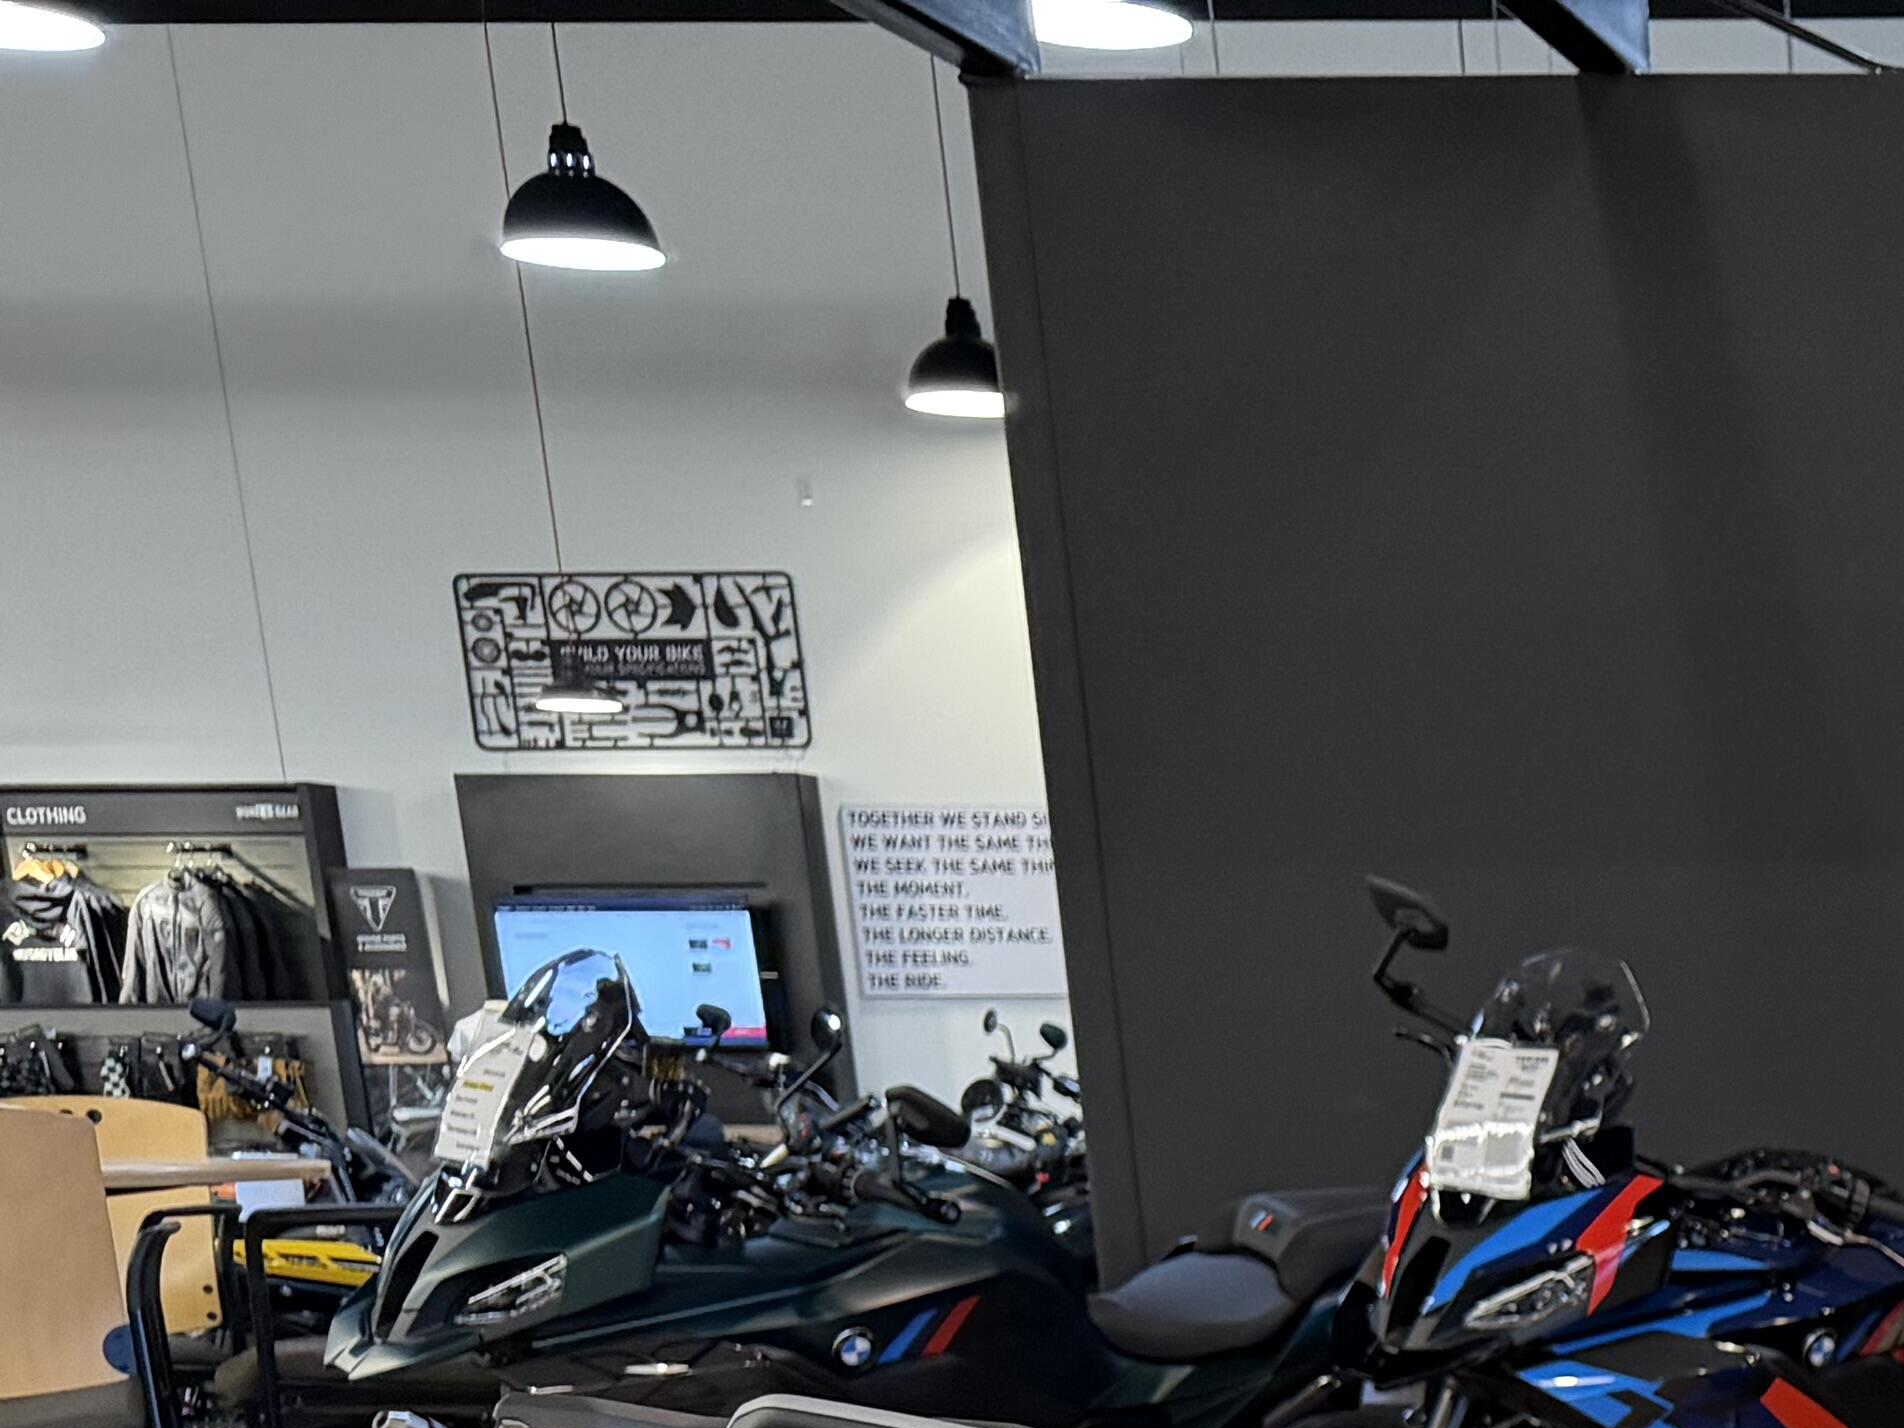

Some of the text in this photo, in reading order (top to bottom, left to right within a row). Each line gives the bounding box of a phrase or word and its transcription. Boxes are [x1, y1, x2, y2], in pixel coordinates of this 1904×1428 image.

[614, 643, 660, 663] YOUR
[664, 643, 704, 663] BIKE
[6, 806, 87, 826] CLOTHING
[848, 810, 934, 827] TOGETHER
[941, 811, 968, 827] WE
[972, 811, 1027, 828] STAND
[851, 834, 877, 850] WE
[882, 834, 931, 850] WANT
[938, 835, 969, 850] THE
[975, 835, 1020, 850] SAME
[854, 857, 880, 873] WE
[885, 857, 925, 874] SEEK
[934, 857, 963, 873] THE
[971, 858, 1016, 874] SAME
[857, 880, 887, 896] THE
[860, 904, 890, 920] THE
[896, 904, 959, 921] FASTER
[863, 927, 893, 942] THE
[900, 927, 964, 943] LONGER
[866, 950, 896, 966] THE
[869, 973, 898, 989] THE
